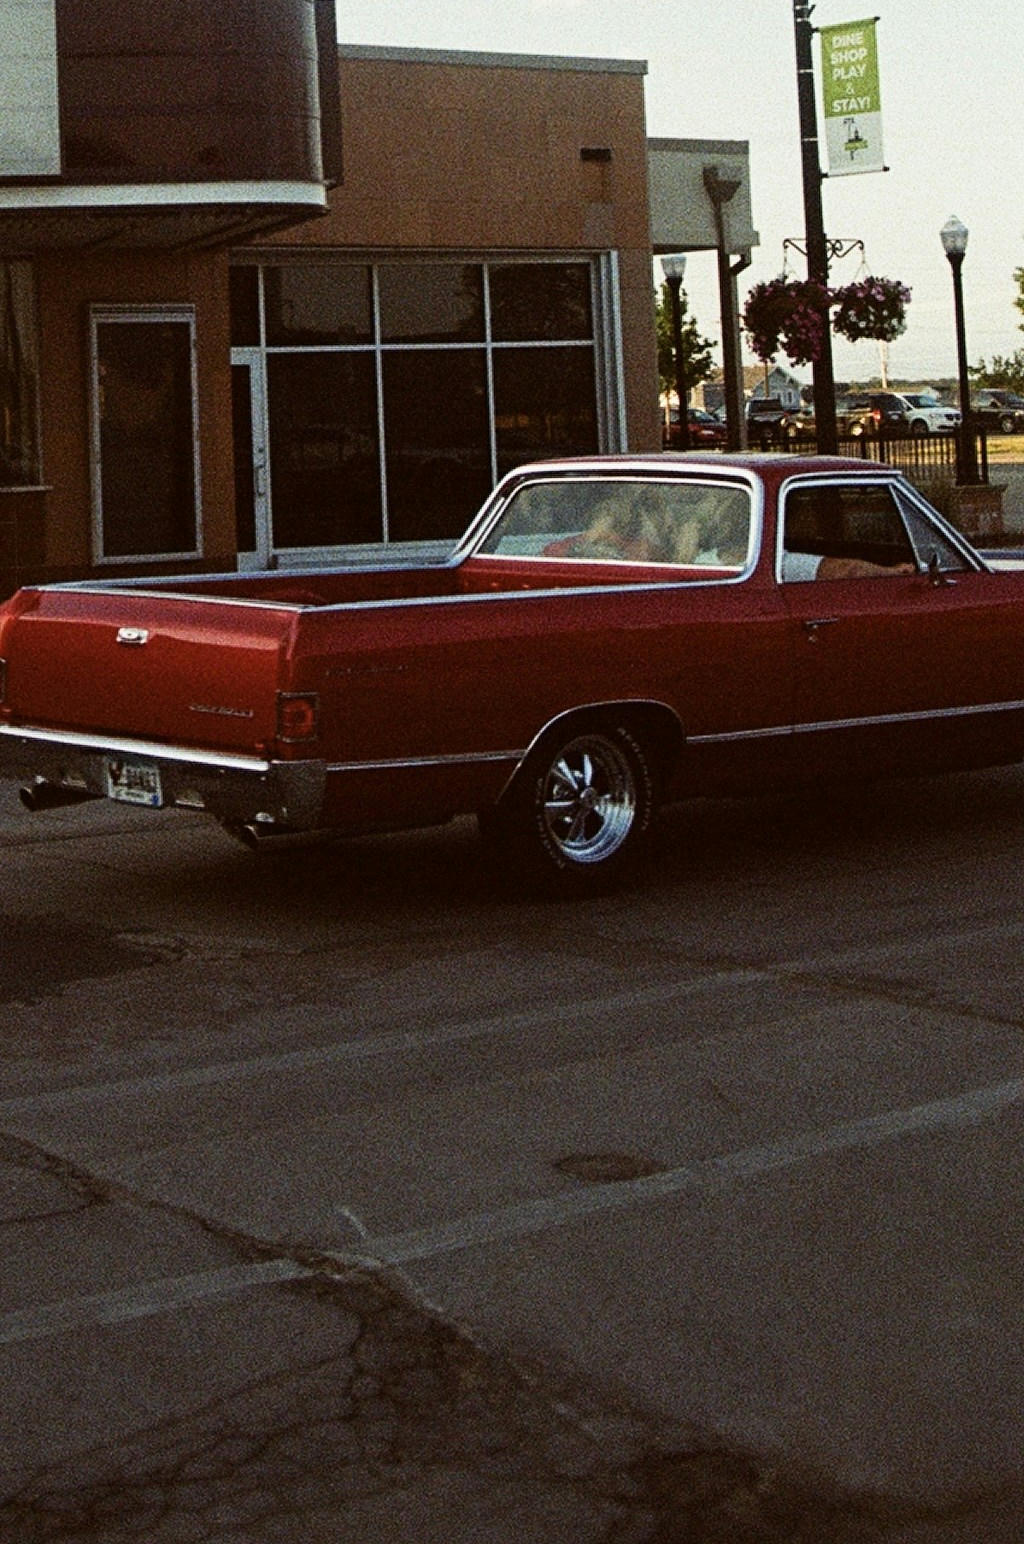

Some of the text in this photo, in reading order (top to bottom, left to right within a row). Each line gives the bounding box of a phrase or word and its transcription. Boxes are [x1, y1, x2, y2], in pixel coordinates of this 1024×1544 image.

[832, 32, 864, 47] DINE
[831, 48, 867, 64] SHOP
[832, 65, 866, 80] PLAY
[832, 97, 870, 112] STAY!
